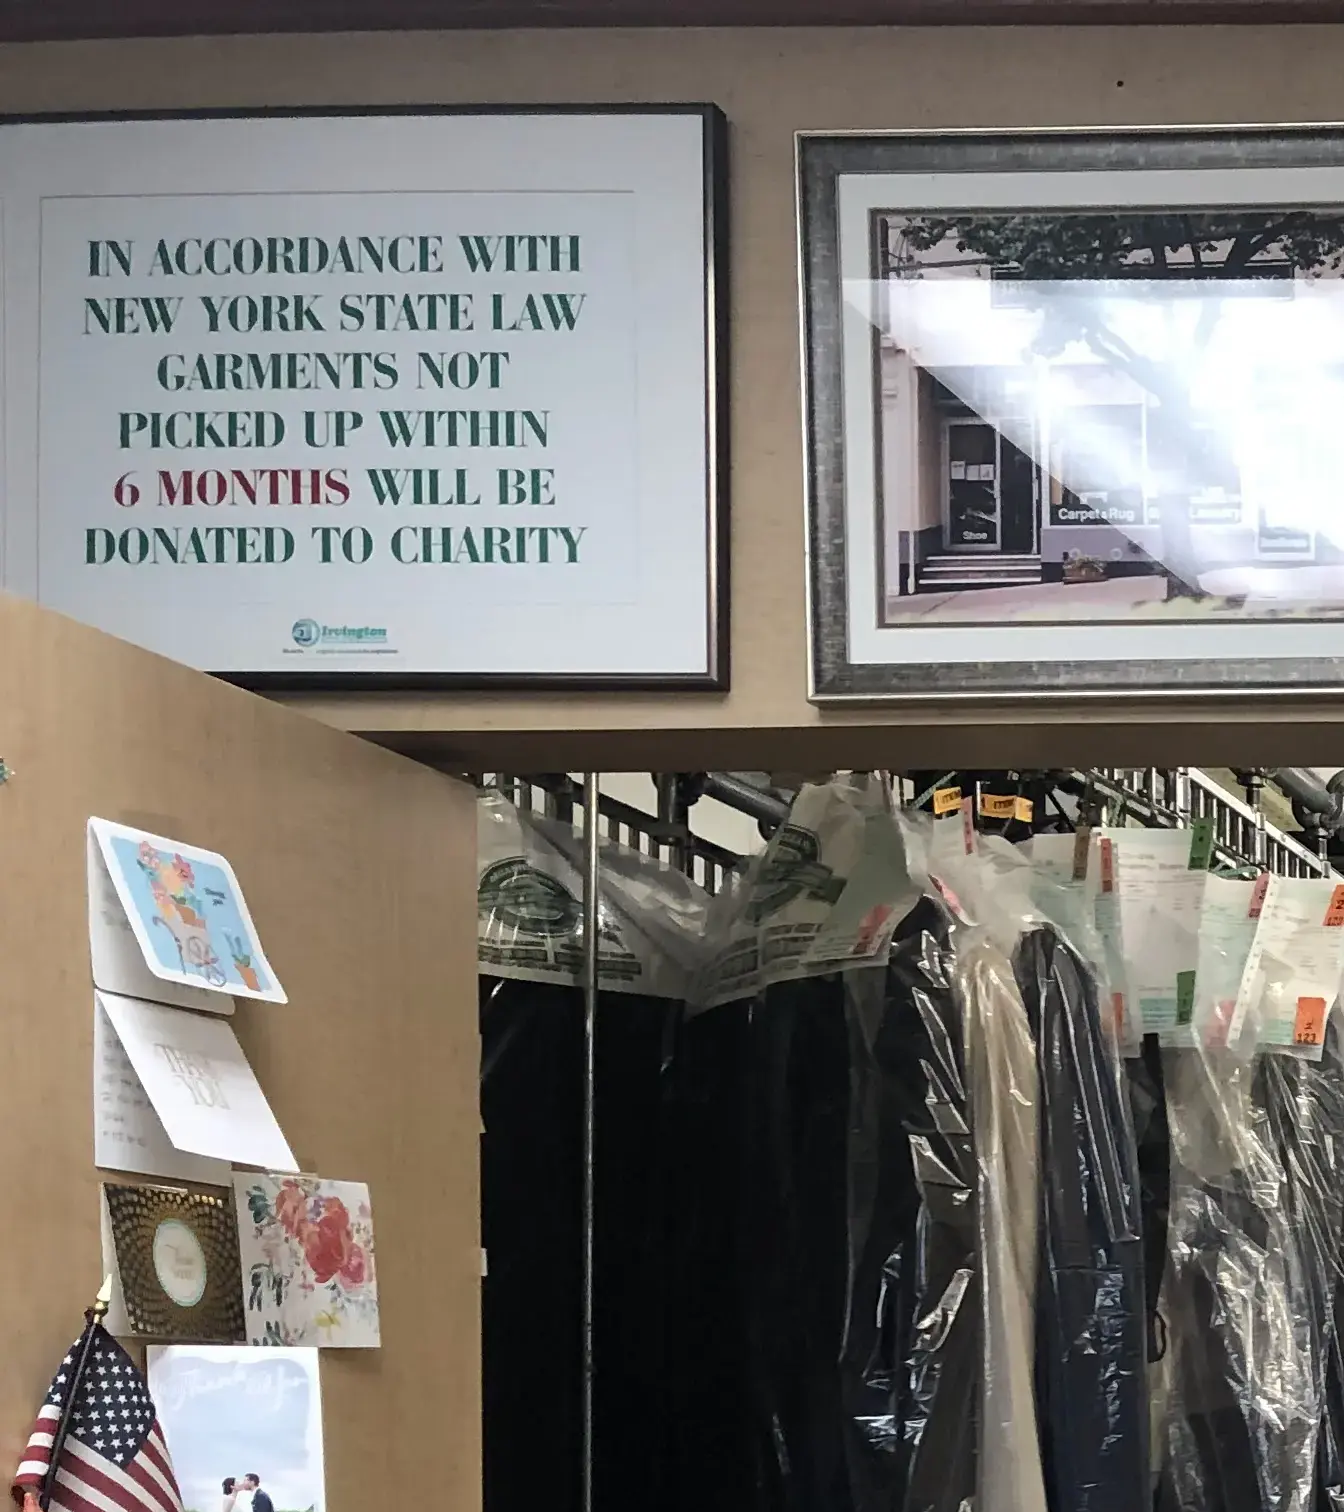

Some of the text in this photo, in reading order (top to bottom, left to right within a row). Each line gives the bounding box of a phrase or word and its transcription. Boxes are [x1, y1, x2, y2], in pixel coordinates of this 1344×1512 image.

[88, 235, 580, 278] IN ACCORDANCE WITH
[84, 294, 587, 335] NEW YORK STATE LAW
[157, 352, 509, 391] GARMENTS NOT
[119, 410, 550, 449] PICKED UP WITHIN
[113, 468, 555, 506] 6 MONTHS WILL BE
[1110, 508, 1135, 522] Rug
[85, 526, 587, 565] DONATED TO CHARITY
